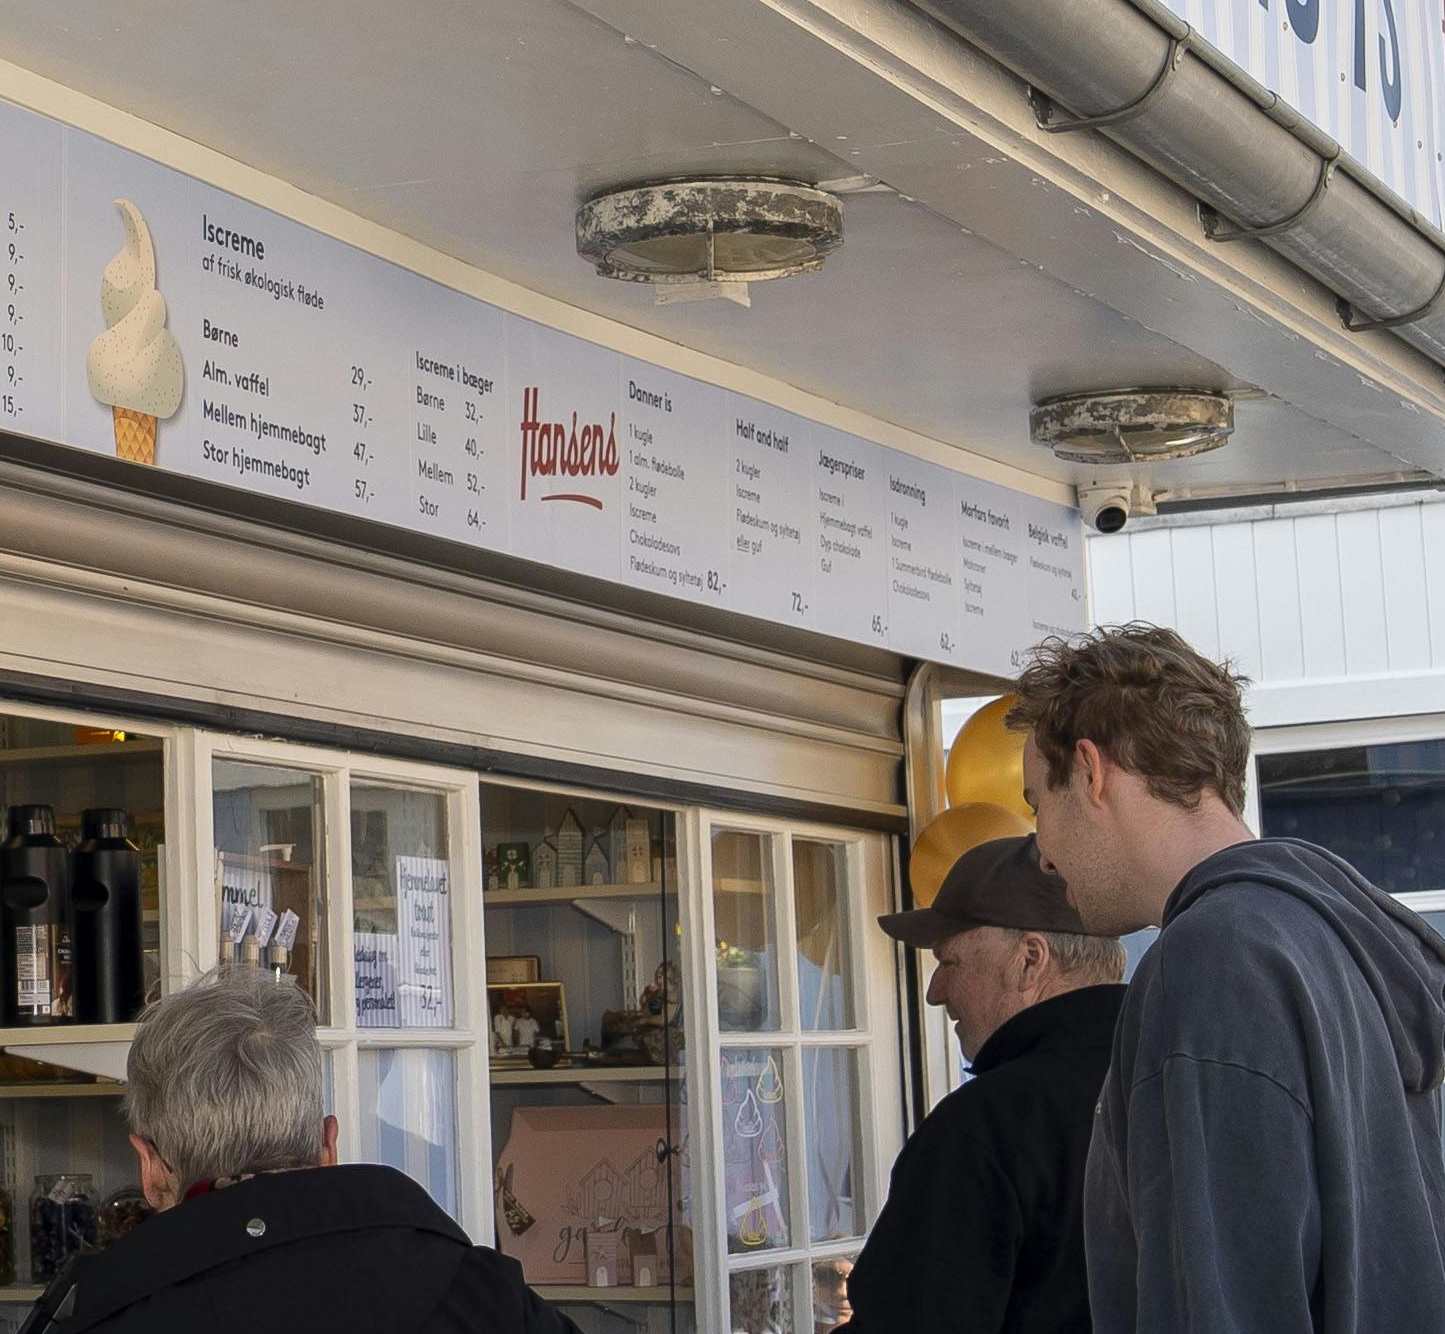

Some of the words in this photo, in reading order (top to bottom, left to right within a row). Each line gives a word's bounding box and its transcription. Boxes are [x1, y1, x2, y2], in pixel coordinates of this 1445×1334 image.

[9, 213, 24, 234] 5,-
[204, 215, 264, 260] Iscreme
[203, 254, 214, 271] af
[218, 257, 241, 281] frisk
[245, 268, 294, 300] økologisk
[298, 285, 323, 309] fløde
[8, 305, 23, 325] 9,-
[2, 333, 22, 355] 10,-
[204, 319, 238, 347] Børne
[352, 366, 372, 389] 29,-
[8, 365, 22, 387] 9,-
[203, 360, 231, 385] Alm.
[235, 373, 268, 396] vaffel
[354, 404, 372, 427] 37,-
[416, 351, 454, 380] Iscreme
[462, 367, 493, 395] bæger
[3, 395, 22, 417] 15,-
[417, 386, 444, 411] Børne
[466, 401, 483, 424] 32,-
[630, 381, 662, 409] Danner
[665, 393, 672, 412] is
[204, 399, 246, 429] Mellem
[251, 413, 326, 455] hjemmebagt
[354, 443, 373, 465] 47,-
[520, 387, 620, 500] Hansens
[204, 440, 228, 464] Stor
[233, 447, 309, 489] hjemmebagt
[356, 479, 374, 502] 57,-
[419, 459, 453, 485] Mellem
[468, 473, 484, 495] 52,-
